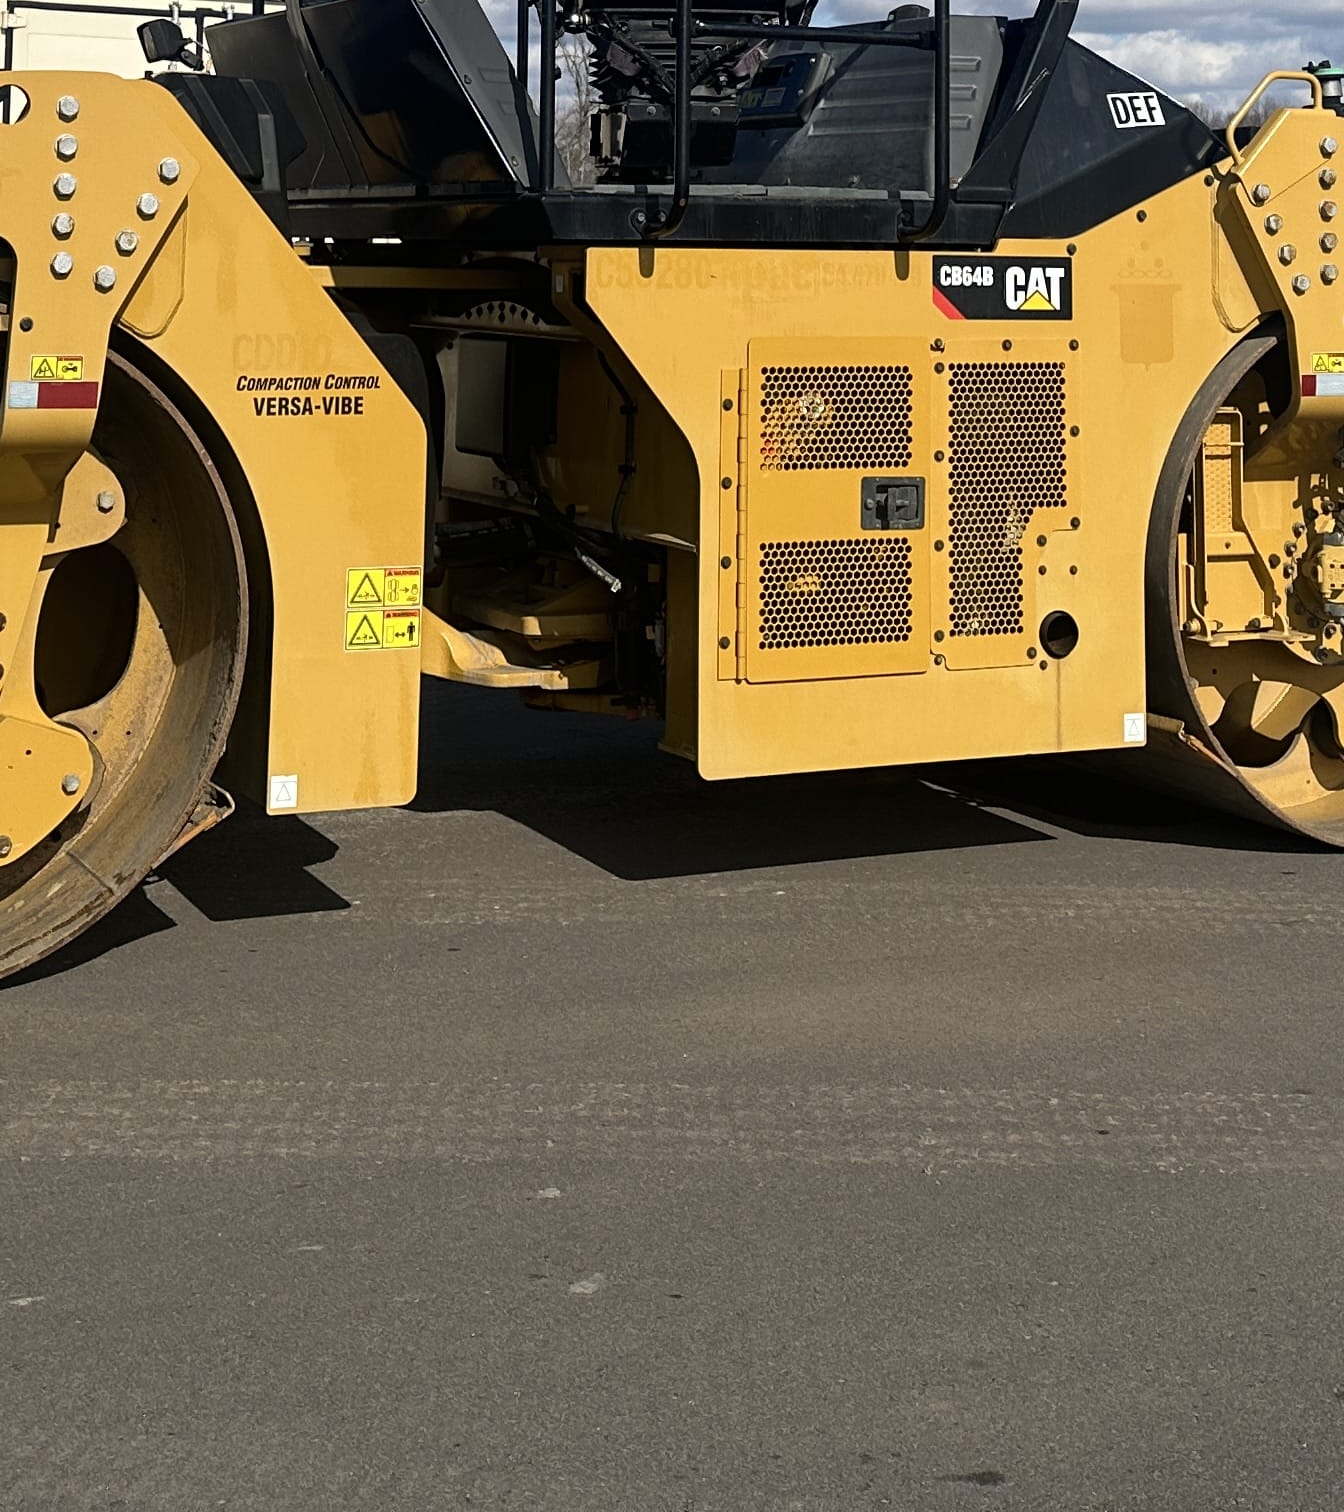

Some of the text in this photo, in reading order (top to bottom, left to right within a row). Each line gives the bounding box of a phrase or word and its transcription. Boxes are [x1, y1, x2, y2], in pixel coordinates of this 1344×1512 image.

[1110, 95, 1157, 125] DEF
[939, 265, 994, 287] CB64B
[1005, 266, 1065, 311] CAT
[236, 374, 381, 391] COMPACTION CONTROL
[253, 396, 364, 416] VERSA-VIBE
